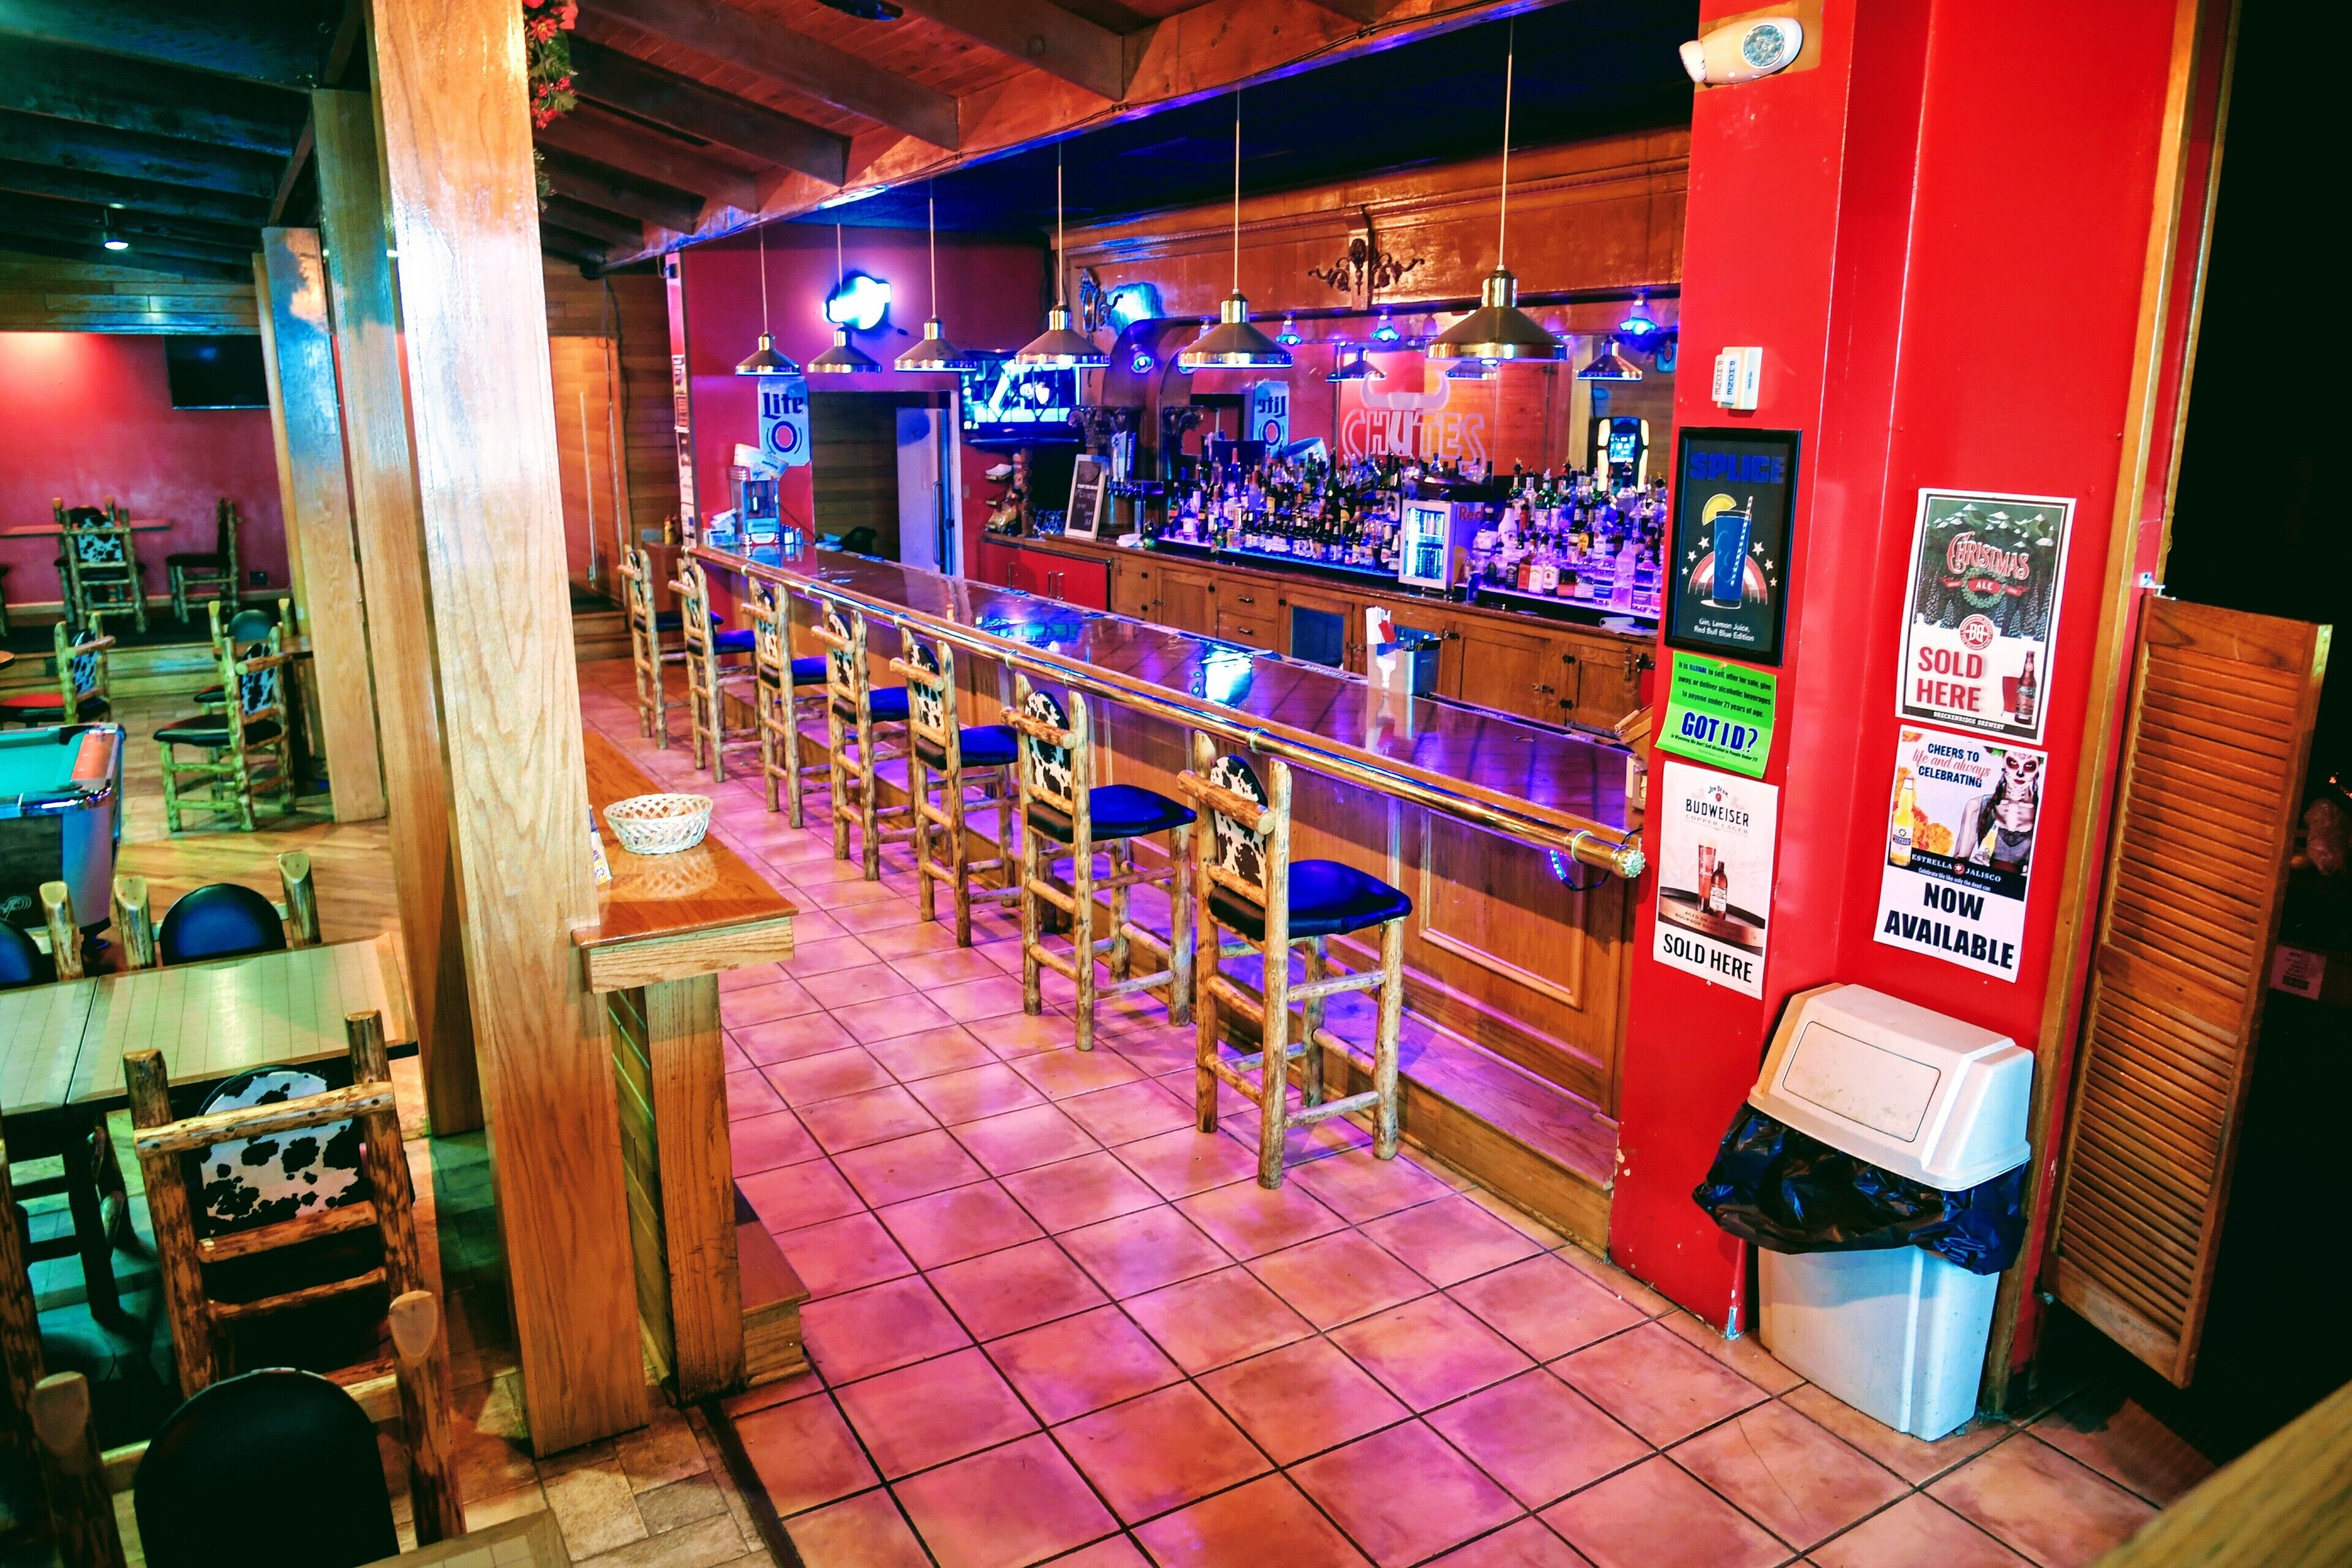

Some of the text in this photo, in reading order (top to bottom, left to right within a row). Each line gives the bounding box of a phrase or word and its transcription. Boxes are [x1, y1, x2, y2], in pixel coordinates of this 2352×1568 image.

[763, 393, 804, 420] Lite
[1341, 409, 1486, 475] CHUTES
[1690, 452, 1787, 484] SPLICE
[1975, 581, 1994, 590] ALE
[1699, 617, 1751, 633] Gin, Lemon Juice,
[1733, 632, 1754, 641] Edition
[1918, 646, 1983, 679] SOLD
[1699, 680, 1717, 691] deliver
[1718, 685, 1743, 698] alcoholic
[1744, 691, 1771, 705] beverages
[1726, 673, 1738, 682] offer
[1760, 682, 1771, 691] give
[1917, 678, 1981, 712] HERE
[1688, 693, 1706, 703] anyone
[1708, 696, 1723, 707] under
[1730, 704, 1745, 713] years
[1752, 709, 1764, 718] age.
[1681, 712, 1720, 742] GOT
[1934, 712, 2005, 730] BRECKENRIDGE BREWERY
[1912, 748, 1991, 778] life and always
[1928, 744, 1980, 762] CHEERS TO
[1918, 766, 1983, 788] CELEBRATING
[1686, 799, 1749, 827] BUDWEISER
[1912, 854, 2002, 883] ESTRELLA JALISCO
[1923, 882, 1985, 921] NOW
[1884, 909, 2015, 970] AVAILABLE
[1663, 933, 1753, 983] SOLD HERE
